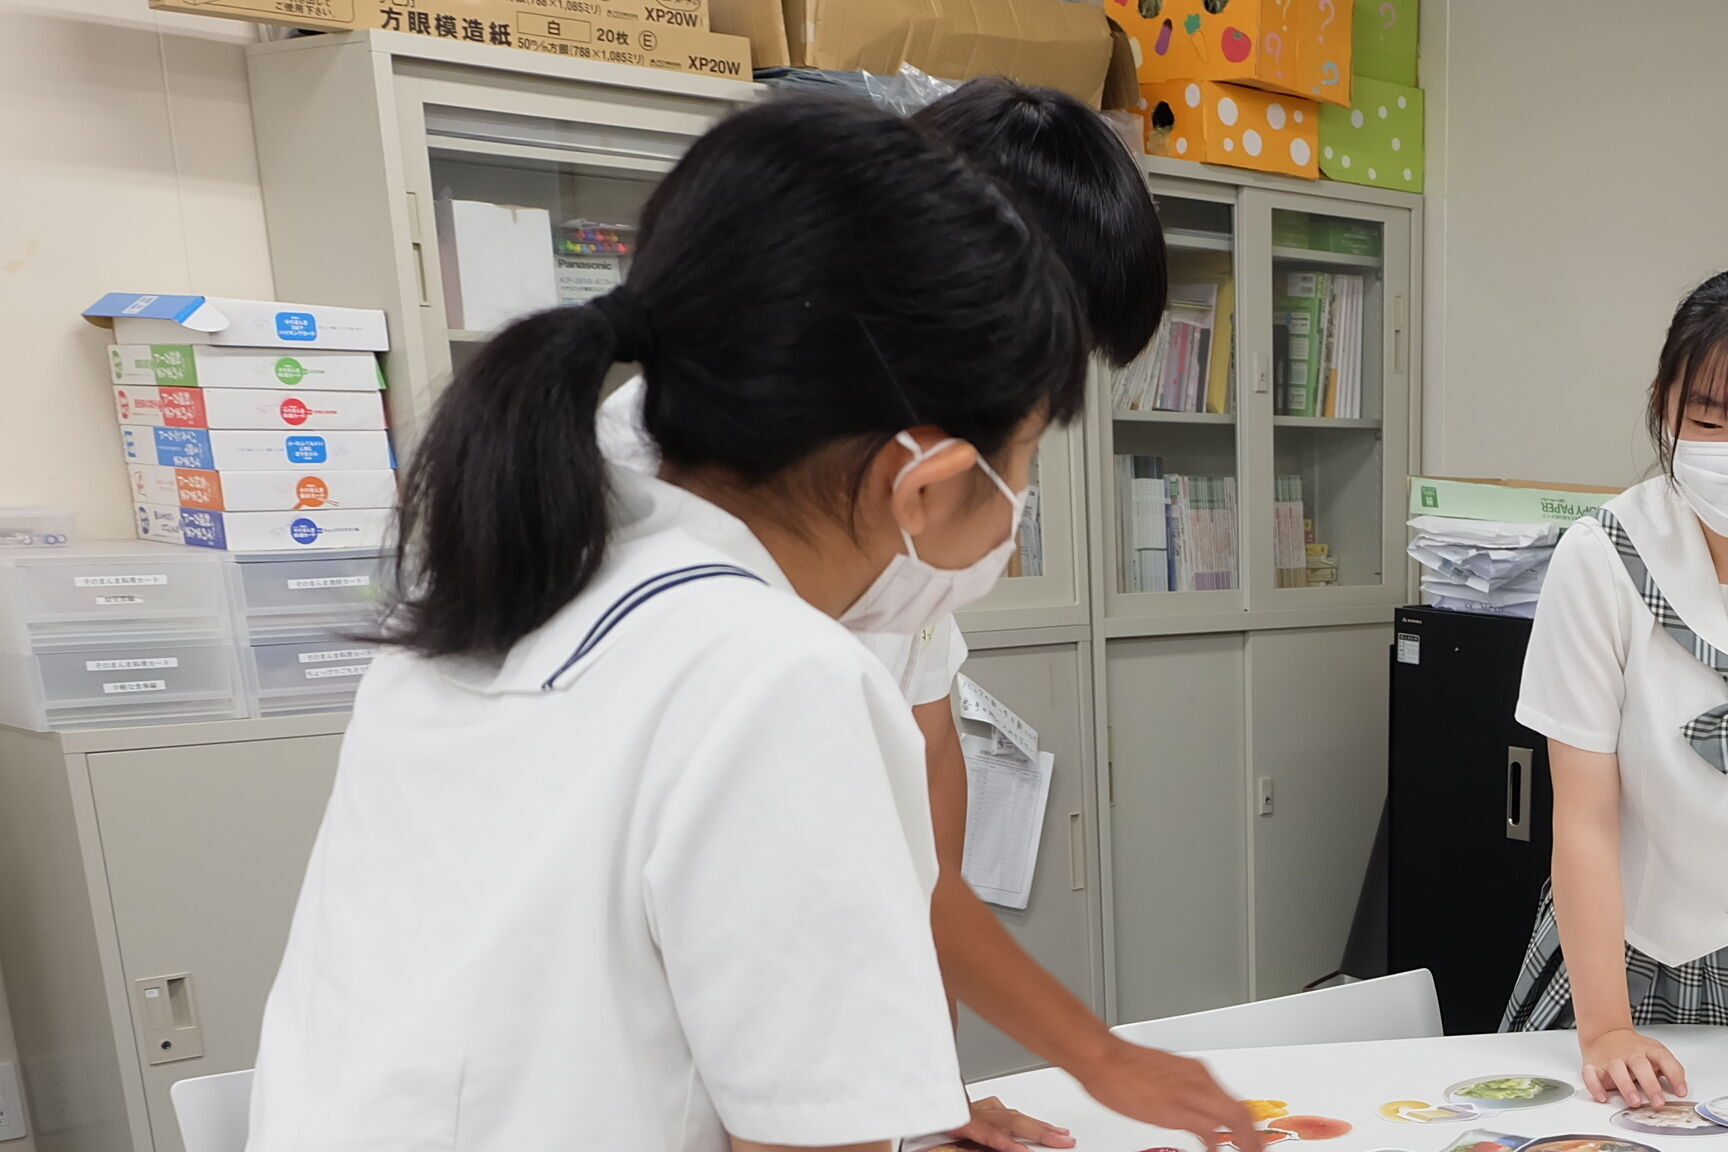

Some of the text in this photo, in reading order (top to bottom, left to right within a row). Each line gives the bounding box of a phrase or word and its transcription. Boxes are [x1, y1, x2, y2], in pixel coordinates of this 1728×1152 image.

[380, 6, 513, 47] 方眼模造紙
[644, 7, 698, 28] XP20W
[547, 20, 561, 36] 白
[596, 28, 629, 46] 20枚
[687, 55, 741, 76] XP20W
[558, 259, 613, 270] Panasonic
[1541, 502, 1574, 514] PAPER
